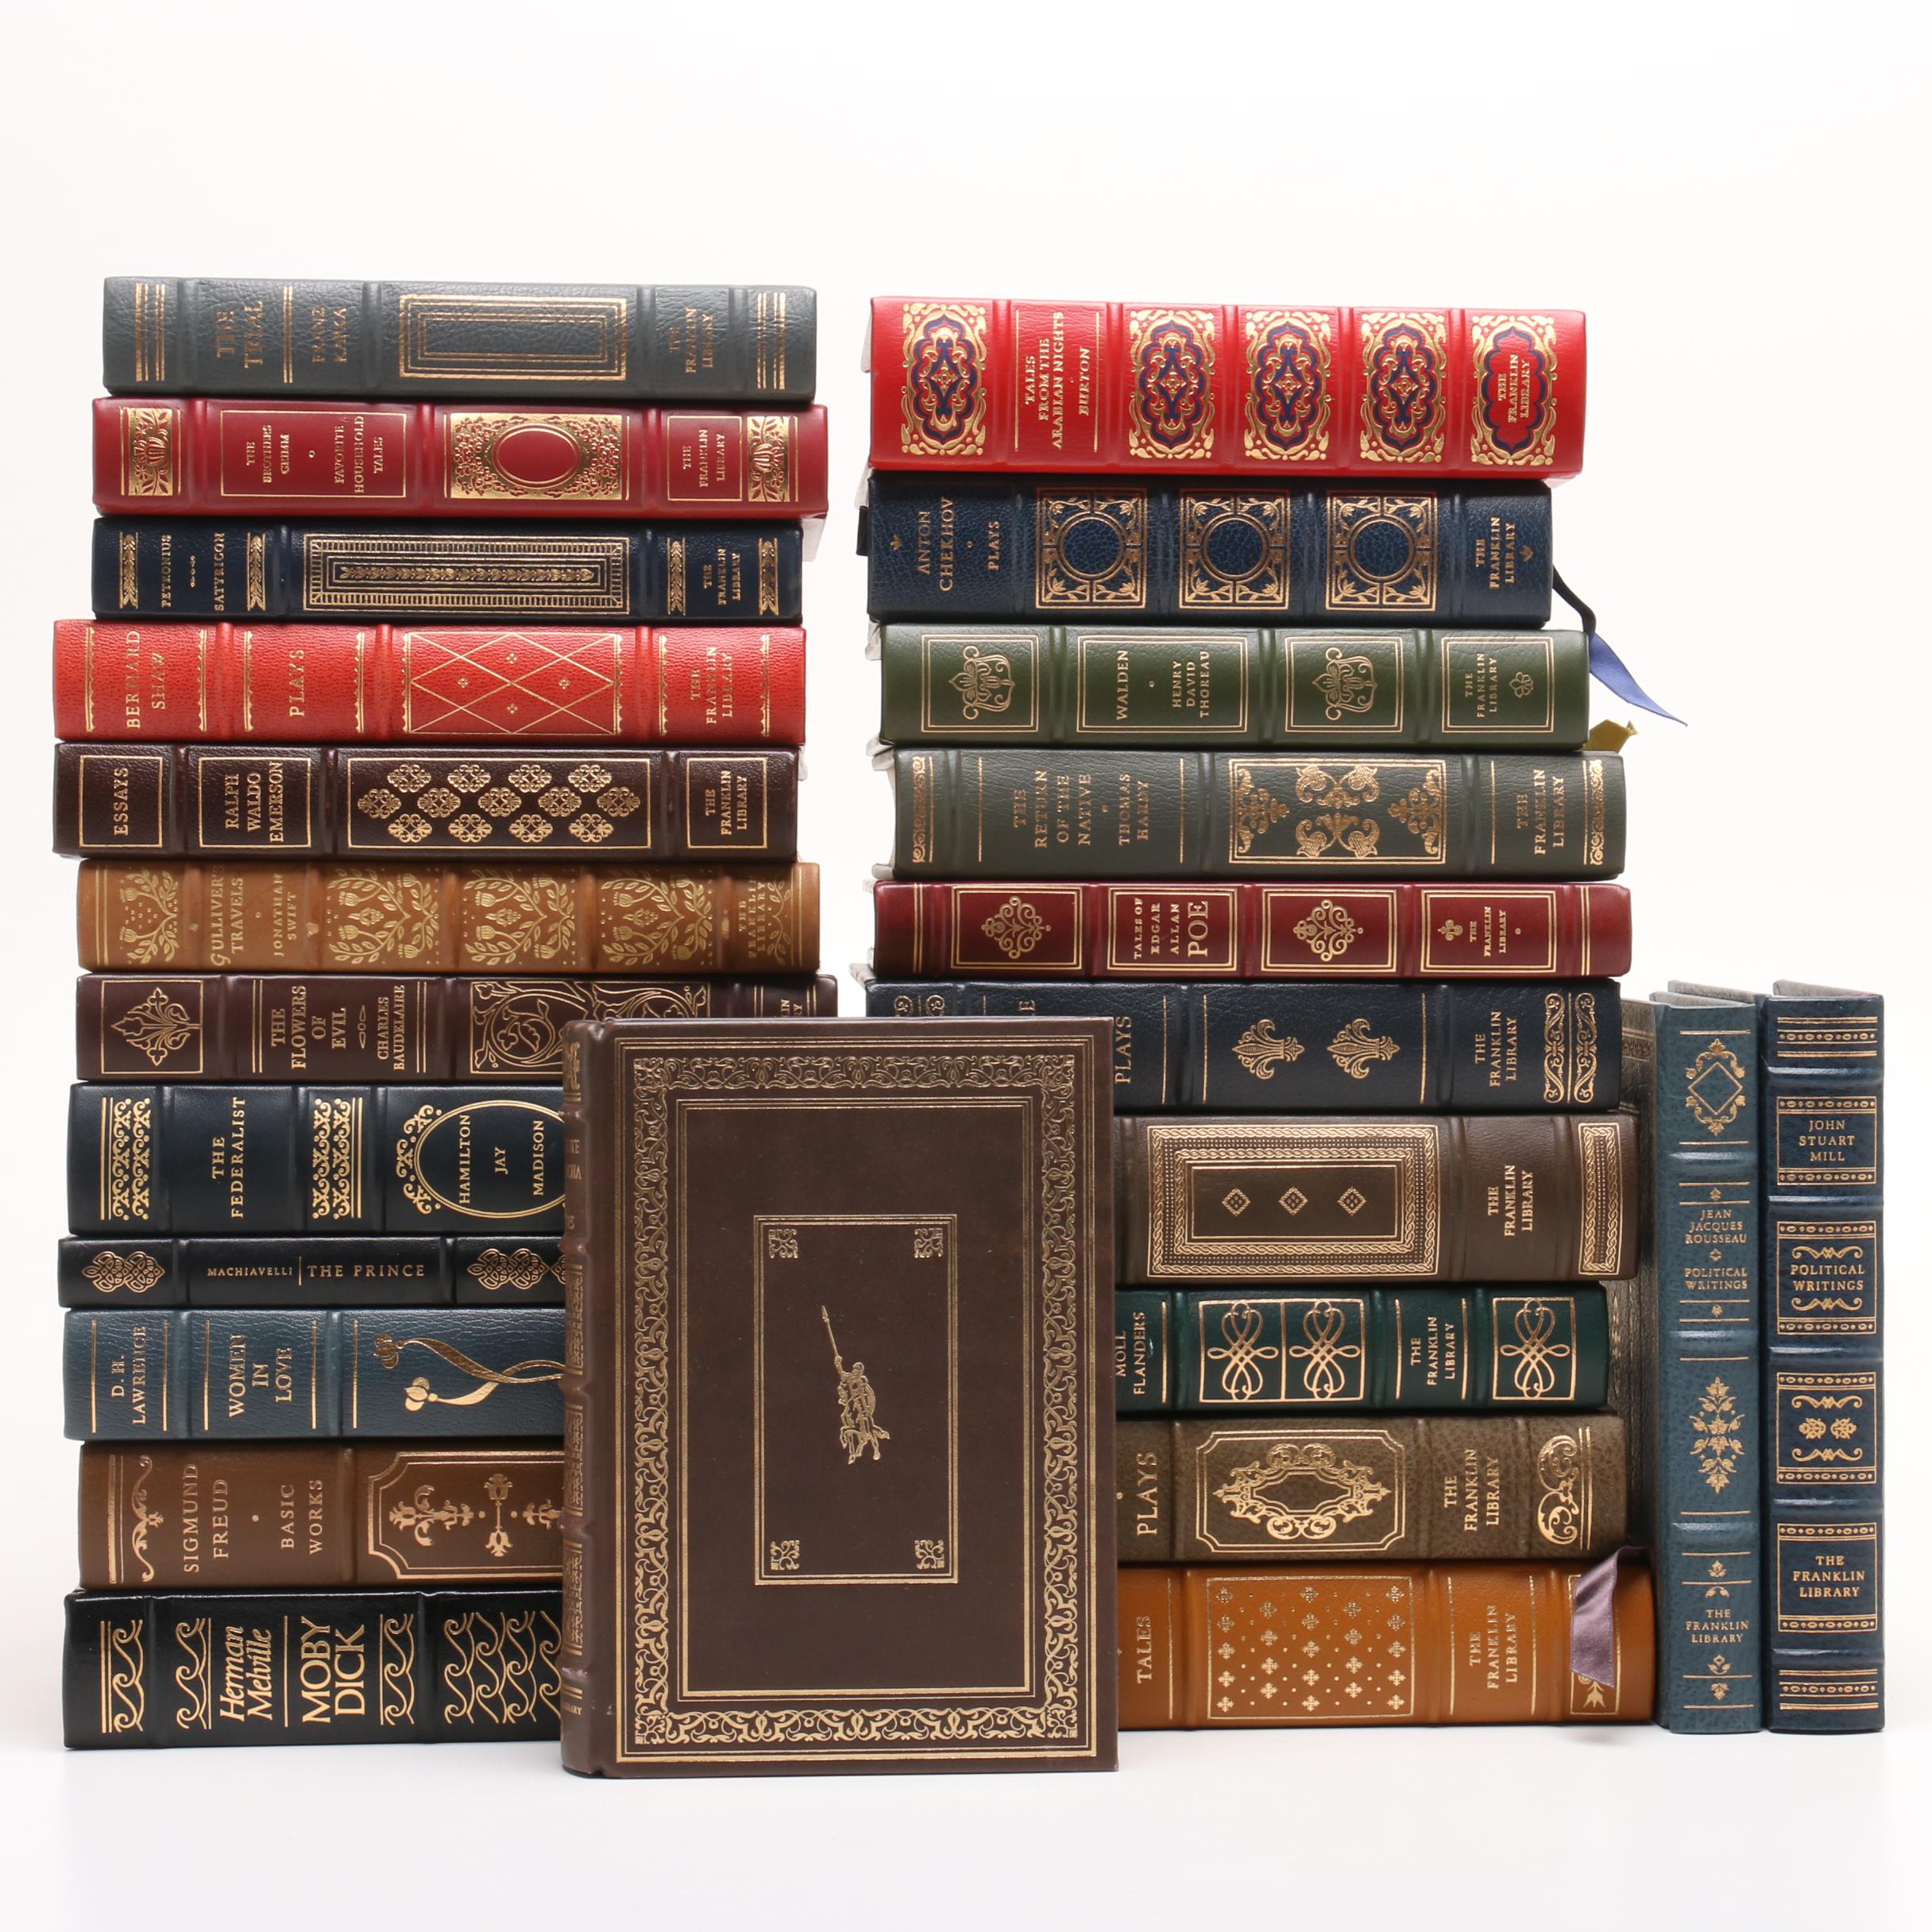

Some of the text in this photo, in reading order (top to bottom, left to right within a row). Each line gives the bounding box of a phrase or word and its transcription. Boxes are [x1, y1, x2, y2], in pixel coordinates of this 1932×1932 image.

[1025, 356, 1036, 405] TALES
[1038, 338, 1050, 421] FROM THE
[1052, 311, 1065, 450] ARABIAN NIGHTS
[1079, 346, 1090, 416] BURTON
[1509, 354, 1518, 423] FRANKLIN
[1520, 359, 1530, 418] LIBRARY
[263, 425, 272, 484] BROTHERS
[280, 435, 290, 474] GRIMM
[334, 425, 344, 484] FAVORITE
[354, 415, 364, 493] HOUSEHOLD
[373, 437, 383, 474] TALES
[699, 429, 709, 488] FRANKLIN
[717, 434, 725, 481] LIBRARY
[161, 535, 172, 608] PETRONIUS
[214, 532, 226, 611] SATYRICON
[918, 511, 931, 575] ANTON
[940, 497, 954, 592] CHEKHOV
[988, 521, 999, 570] PLAYS
[1476, 539, 1486, 567] THE
[1490, 517, 1501, 589] FRANKLIN
[1505, 523, 1515, 583] LIBRARY
[703, 564, 713, 589] THE
[717, 548, 726, 605] FRANKLIN
[126, 630, 140, 729] BERNARD
[152, 652, 165, 709] SHAW
[290, 650, 304, 717] PLAYS
[691, 670, 701, 700] THE
[706, 647, 717, 724] FRANKLIN
[722, 652, 732, 717] LIBRARY
[1117, 650, 1128, 720] WALDEN
[1172, 660, 1182, 708] HENRY
[1186, 661, 1196, 707] DAVID
[1200, 651, 1210, 718] THOREAU
[114, 767, 129, 836] ESSAYS
[226, 774, 239, 829] RALPH
[247, 773, 261, 832] WALDO
[269, 761, 284, 843] EMERSON
[705, 789, 716, 816] THE
[721, 770, 732, 836] FRANKLIN
[737, 775, 748, 830] LIBRARY
[1014, 789, 1026, 828] THE
[1035, 770, 1048, 848] RETURN
[1057, 775, 1069, 844] OF THE
[1078, 774, 1092, 846] NATIVE
[1119, 773, 1131, 846] THOMAS
[1138, 780, 1149, 840] HARDY
[1517, 794, 1528, 829] THE
[1534, 769, 1546, 856] FRANKLIN
[1553, 775, 1564, 848] LIBRARY
[231, 878, 244, 953] TRAVELS
[273, 874, 284, 957] JONATHAN
[288, 892, 297, 941] SWIFT
[1134, 897, 1143, 960] TALES OF
[1151, 902, 1161, 955] EDGAR
[1170, 903, 1180, 955] ALLAN
[1188, 901, 1208, 957] POE
[271, 1008, 285, 1047] THE
[292, 985, 306, 1069] FLOWERS
[312, 1015, 326, 1040] OF
[332, 1007, 346, 1049] EVIL
[377, 996, 389, 1060] CHARLES
[393, 984, 405, 1070] BAUDELAIRE
[1115, 1016, 1132, 1084] PLAYS
[1475, 1033, 1486, 1065] THE
[1490, 1011, 1501, 1087] FRANKLIN
[1506, 1018, 1517, 1081] LIBRARY
[1799, 1136, 1855, 1146] STUART
[1809, 1120, 1845, 1133] JOHN
[1810, 1152, 1845, 1161] MILL
[211, 1137, 225, 1180] THE
[230, 1096, 245, 1219] FEDERALIST
[459, 1114, 470, 1204] HAMILTON
[495, 1147, 508, 1175] JAY
[533, 1120, 544, 1196] MADISON
[1488, 1186, 1499, 1216] THE
[1504, 1164, 1517, 1237] FRANKLIN
[1522, 1170, 1533, 1231] LIBRARY
[1689, 1222, 1743, 1232] JACQUES
[1700, 1210, 1732, 1219] JEAN
[1685, 1235, 1747, 1243] ROUSSEAU
[207, 1265, 424, 1277] MACHIAVELLI THE PRINCE
[1684, 1268, 1748, 1277] POLITICAL
[1686, 1281, 1748, 1289] WRITINGS
[1791, 1265, 1865, 1275] POLITICAL
[1793, 1281, 1864, 1291] WRITINGS
[111, 1354, 125, 1398] D. H.
[133, 1326, 146, 1424] LAWRENCE
[229, 1335, 246, 1418] WOMEN
[253, 1363, 269, 1388] IN
[276, 1347, 292, 1402] LOVE
[1115, 1331, 1126, 1377] MOLL
[1134, 1312, 1146, 1395] FLANDERS
[1411, 1338, 1420, 1366] THE
[1427, 1316, 1438, 1385] FRANKLIN
[1445, 1323, 1455, 1379] LIBRARY
[183, 1463, 199, 1573] SIGMUND
[213, 1479, 229, 1559] FREUD
[280, 1484, 294, 1549] BASIC
[309, 1479, 323, 1555] WORKS
[1138, 1452, 1158, 1536] PLAYS
[1444, 1475, 1457, 1508] THE
[1464, 1449, 1477, 1532] FRANKLIN
[1486, 1457, 1499, 1525] LIBRARY
[1793, 1571, 1865, 1582] FRANKLIN
[1816, 1556, 1844, 1566] THE
[1706, 1609, 1732, 1618] THE
[1799, 1587, 1860, 1598] LIBRARY
[1137, 1616, 1152, 1684] TALES
[1470, 1633, 1481, 1667] THE
[1487, 1604, 1498, 1689] FRANKLIN
[1505, 1613, 1517, 1683] LIBRARY
[1686, 1621, 1749, 1631] FRANKLIN
[1691, 1634, 1744, 1643] LIBRARY
[220, 1625, 245, 1722] Herman
[247, 1629, 272, 1721] Melville
[300, 1615, 331, 1724] MOBY
[334, 1624, 365, 1716] DICK
